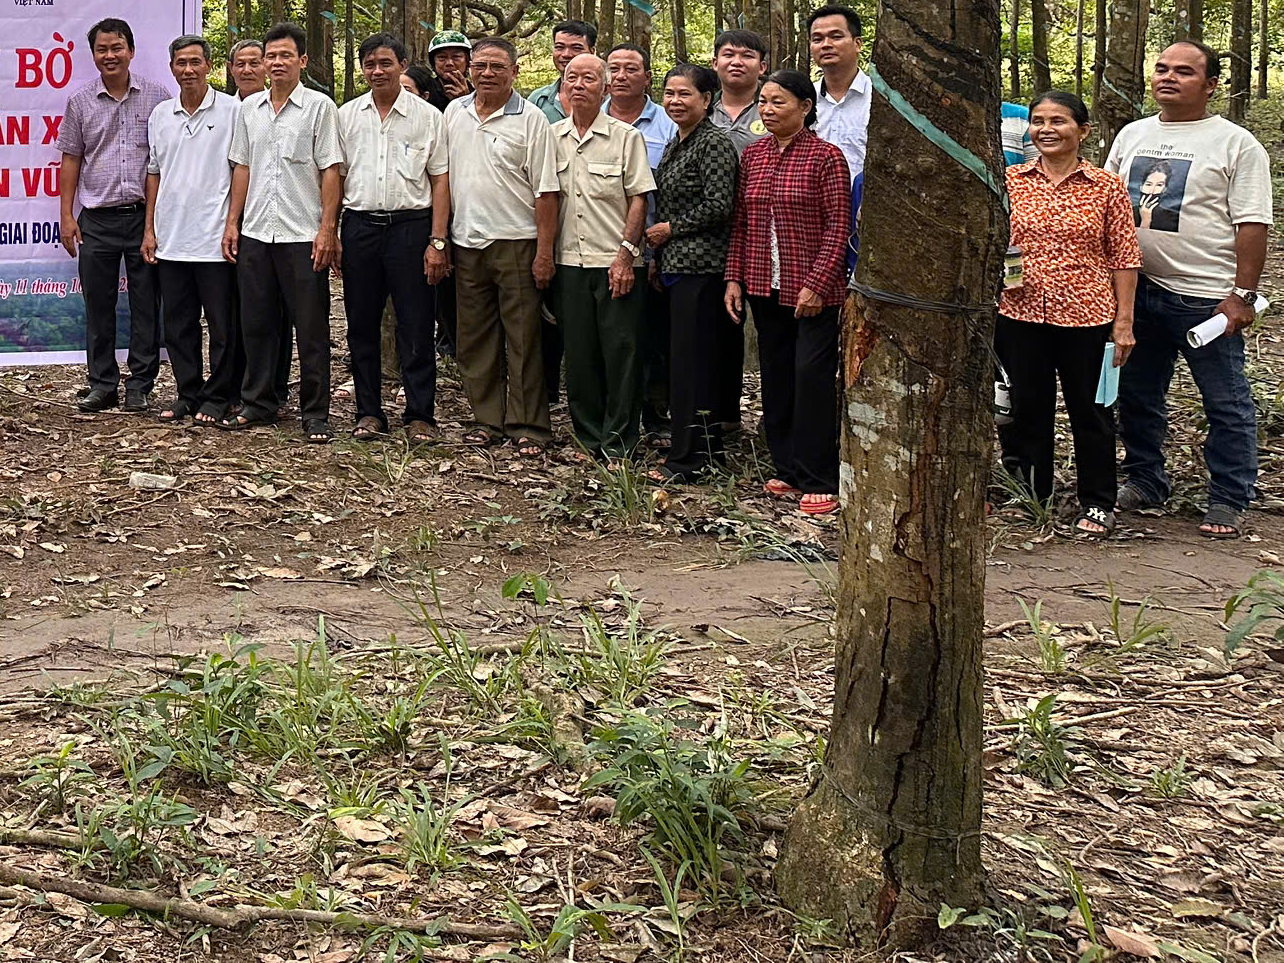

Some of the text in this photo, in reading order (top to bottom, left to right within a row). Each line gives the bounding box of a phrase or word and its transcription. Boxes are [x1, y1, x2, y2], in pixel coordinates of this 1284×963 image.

[15, 31, 74, 90] BỜ
[1164, 151, 1195, 159] woman
[31, 221, 62, 248] ĐOẠ
[14, 279, 28, 296] 11
[30, 277, 68, 299] tháng
